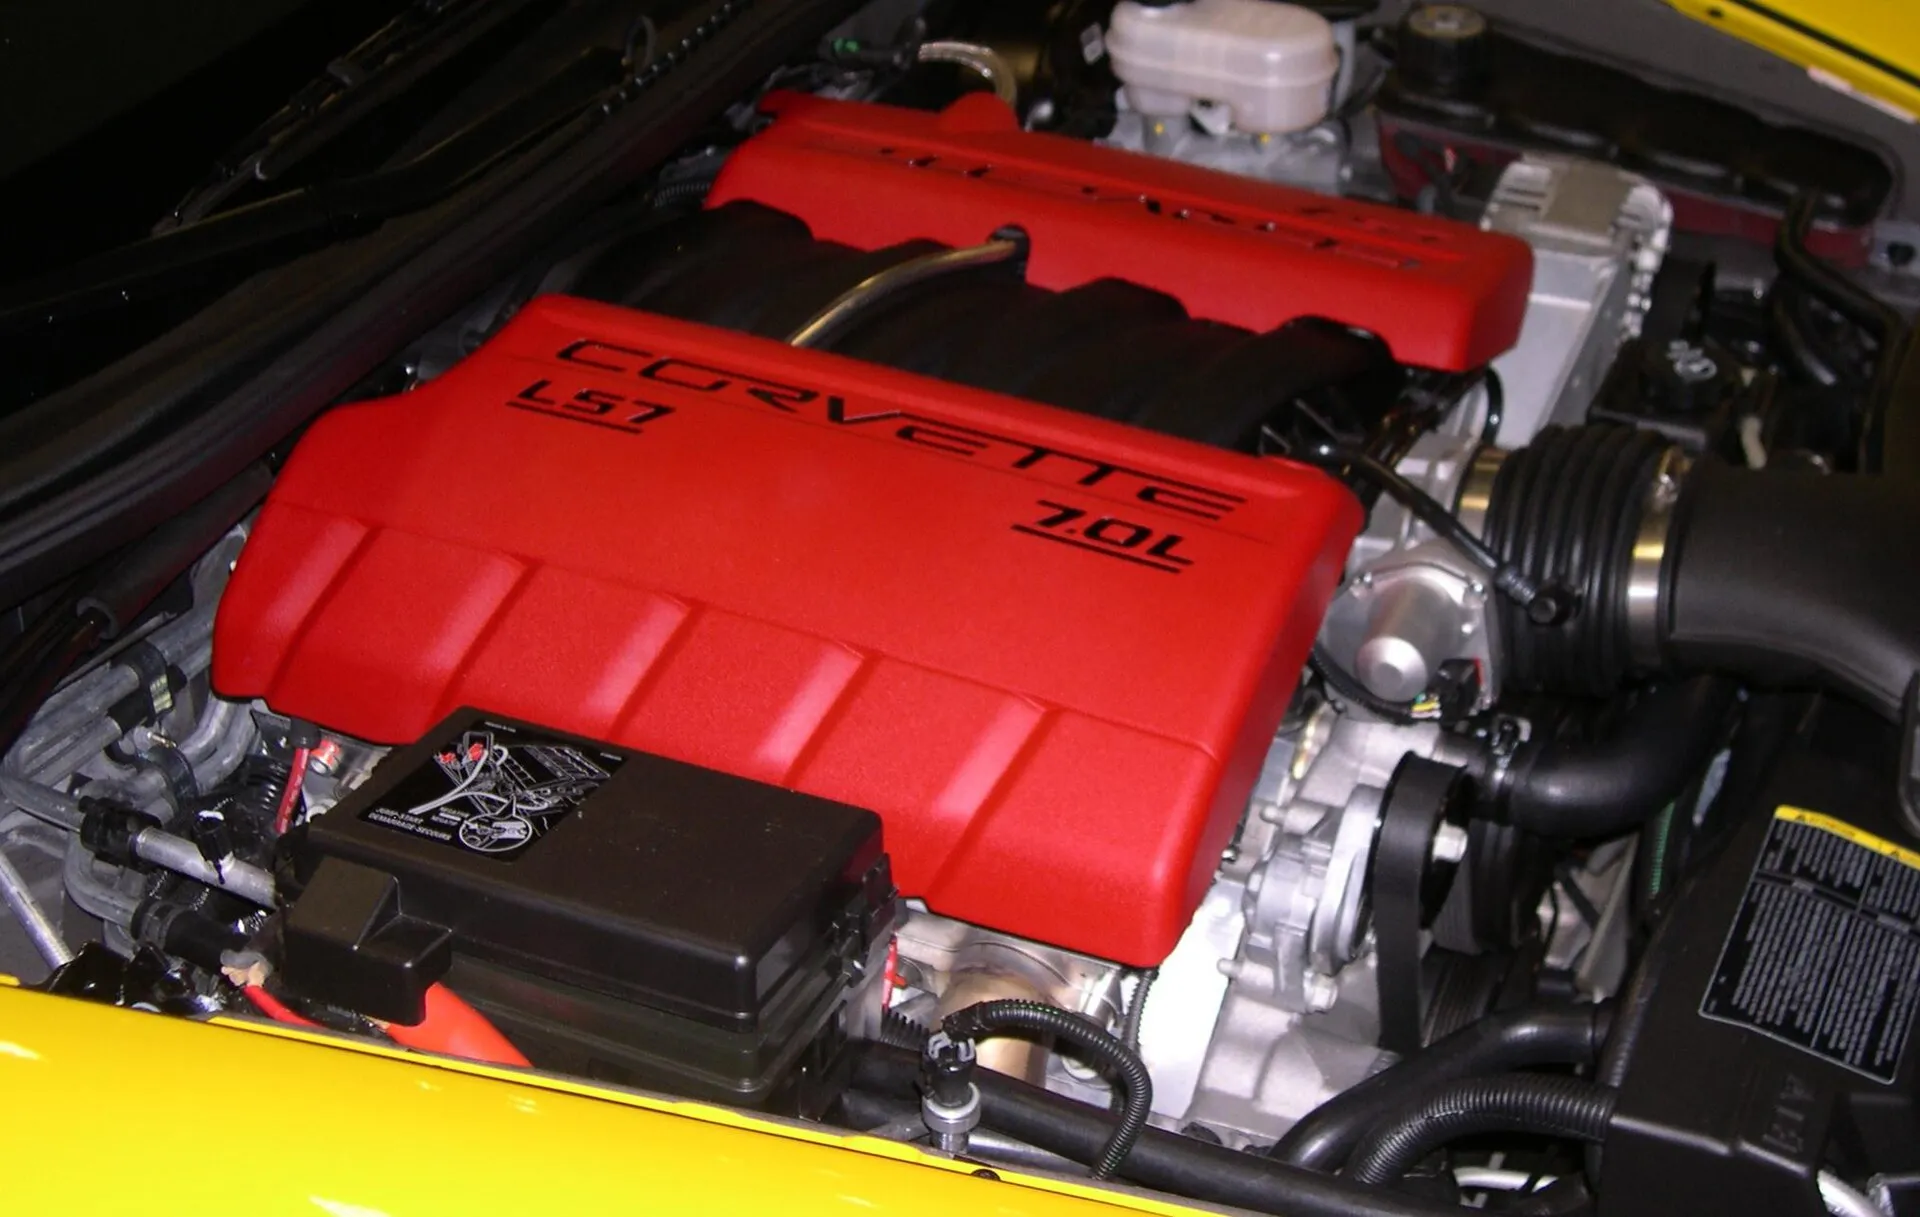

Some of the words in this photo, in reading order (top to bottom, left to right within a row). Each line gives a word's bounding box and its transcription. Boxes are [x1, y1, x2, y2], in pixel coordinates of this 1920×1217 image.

[517, 379, 675, 425] LS7
[556, 338, 1248, 521] CORVETTE
[1034, 499, 1195, 567] 7.0L
